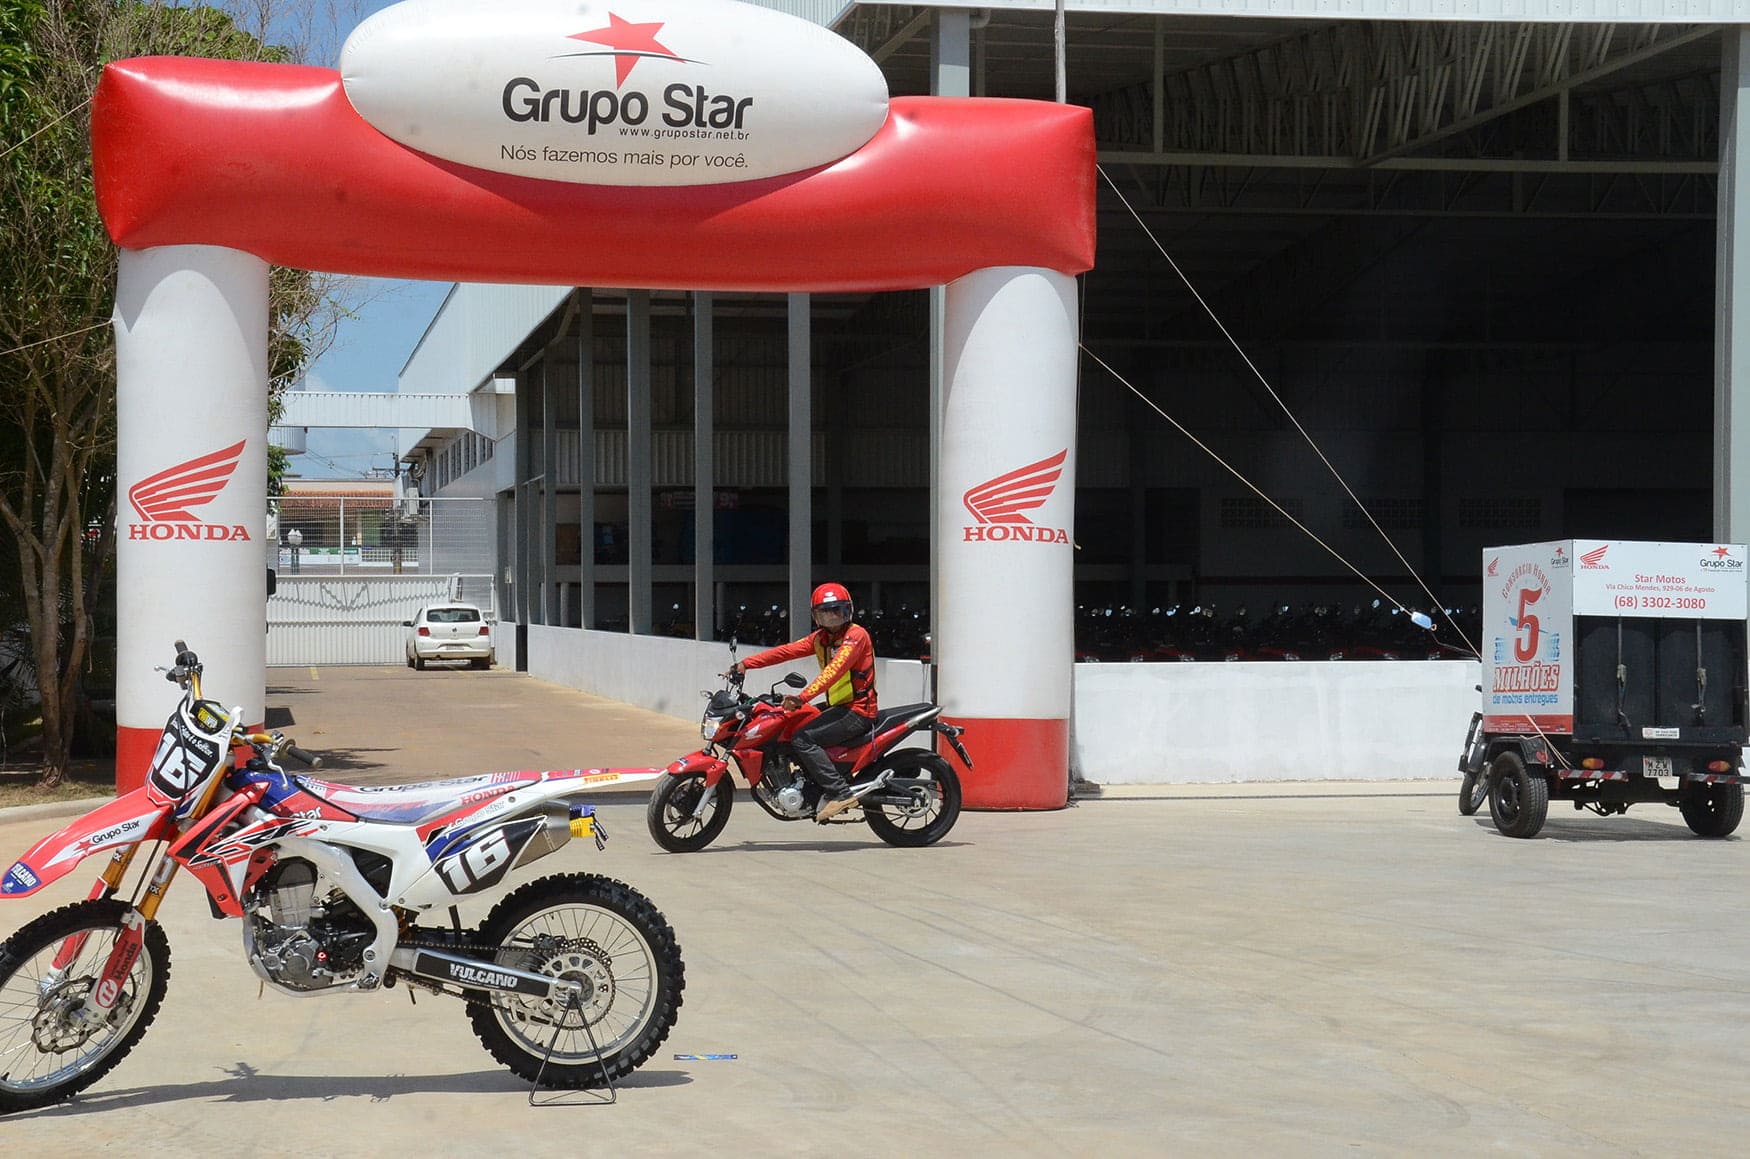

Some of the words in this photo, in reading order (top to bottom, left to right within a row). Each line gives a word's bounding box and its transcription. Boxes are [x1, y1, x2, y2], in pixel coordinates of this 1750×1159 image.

[502, 77, 649, 135] Grupo
[662, 83, 753, 129] Star
[619, 127, 750, 140] www.grupostar.net.br
[501, 145, 537, 162] Nós
[542, 146, 618, 164] fazemos
[623, 150, 664, 165] mais
[669, 155, 700, 169] por
[704, 152, 749, 168] você.
[128, 524, 251, 541] HONDA
[963, 525, 1069, 544] HONDA
[1700, 559, 1725, 568] Grupo
[1726, 559, 1743, 568] Star
[1634, 574, 1652, 582] Star
[1656, 575, 1686, 583] Motos
[1614, 595, 1638, 609] (68)
[1642, 597, 1706, 609] 3302-3080
[1513, 588, 1543, 663] 5
[1647, 769, 1669, 777] 7703
[461, 785, 517, 805] HONDA
[92, 828, 121, 844] Grupo
[121, 820, 140, 832] Star
[442, 829, 511, 892] 16
[450, 963, 518, 988] VULCANO
